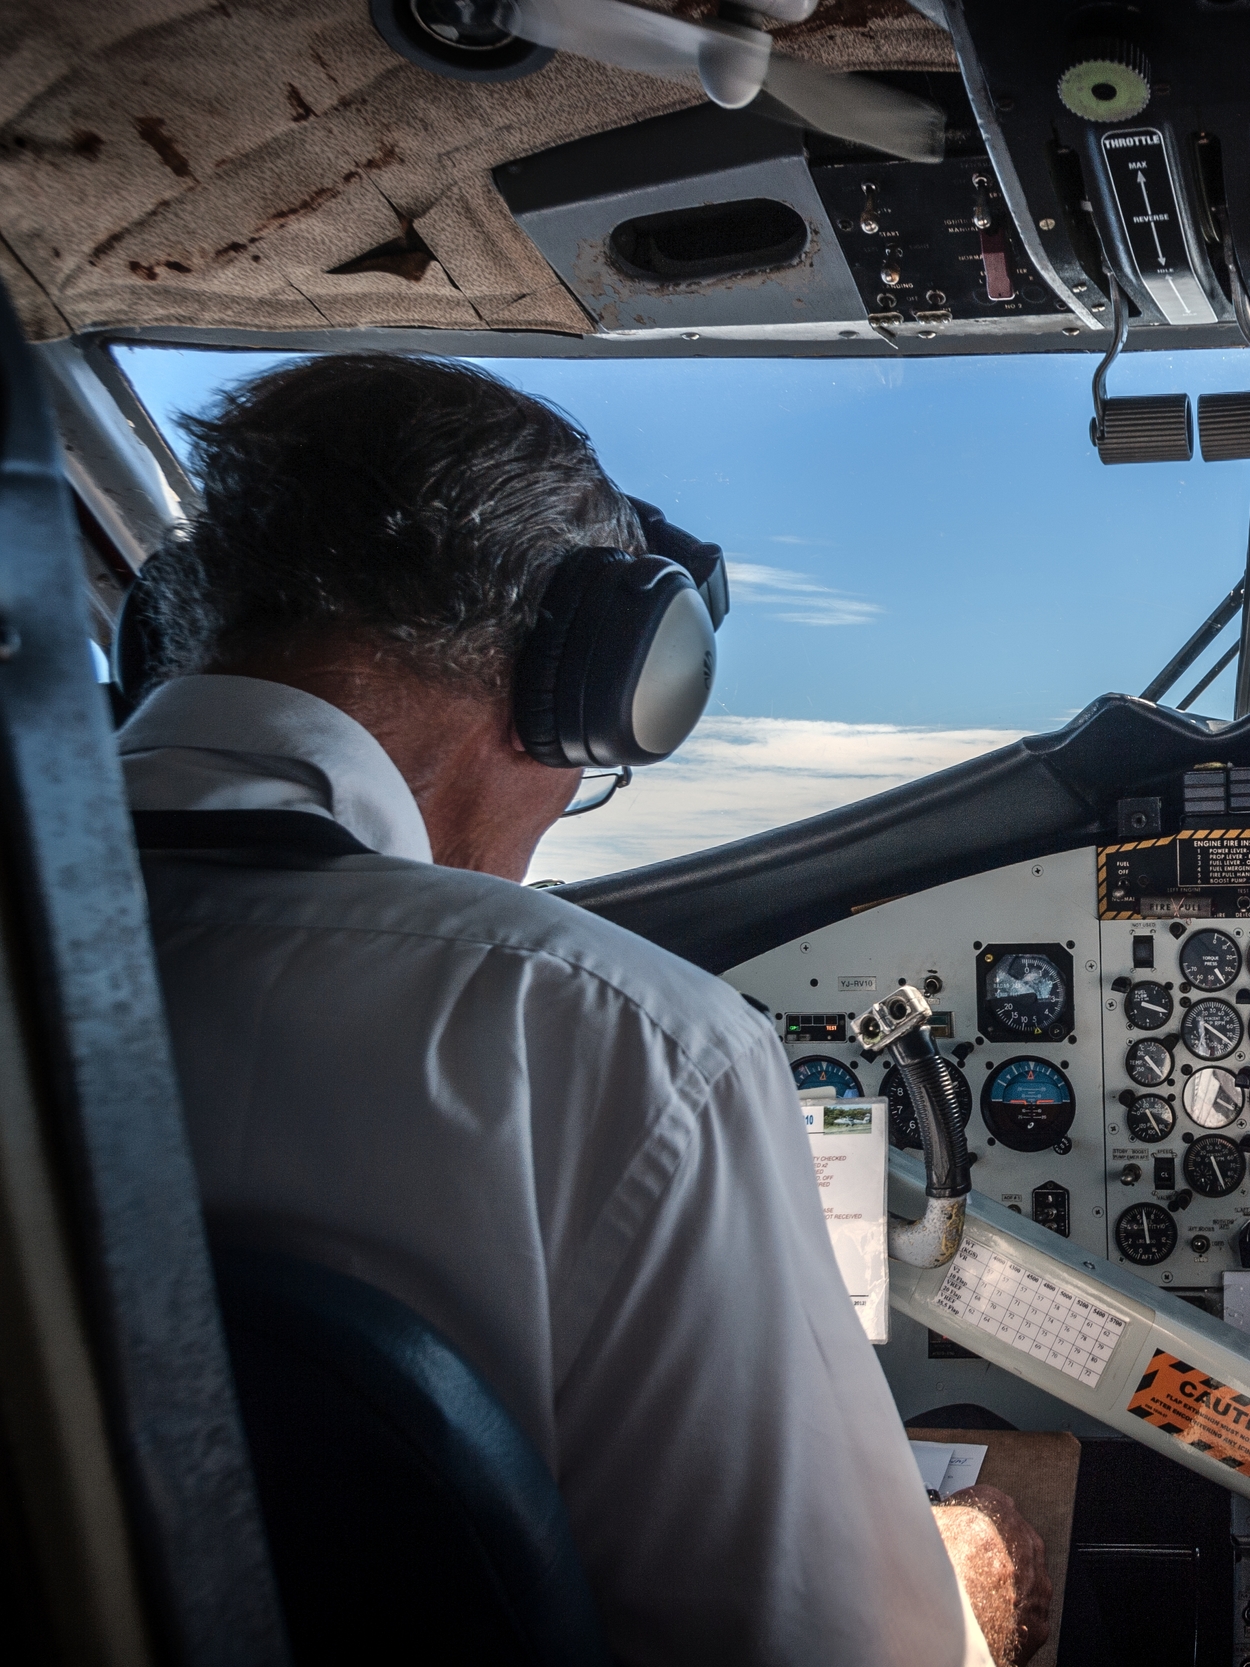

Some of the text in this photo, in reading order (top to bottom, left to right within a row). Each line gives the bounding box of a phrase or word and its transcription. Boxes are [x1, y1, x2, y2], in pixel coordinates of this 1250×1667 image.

[1104, 134, 1160, 150] THROTTLE
[1128, 161, 1148, 170] MAX
[1133, 213, 1169, 223] REVERSE
[1149, 902, 1201, 911] FIRE PULL
[840, 980, 873, 988] YJ-RV10
[897, 1087, 904, 1096] 8
[896, 1105, 903, 1114] 7
[909, 1120, 916, 1129] 6
[965, 1240, 975, 1249] WT
[959, 1253, 968, 1261] VR
[961, 1246, 979, 1260] (KGS)
[952, 1265, 961, 1273] V2
[947, 1279, 962, 1291] VREF
[1008, 1264, 1123, 1327] 4300 4500 4800 5000 5200 5400 5700
[1166, 1394, 1182, 1406] FLAP
[1220, 1422, 1239, 1435] MUST
[1150, 1396, 1172, 1411] AFTER
[1222, 1437, 1236, 1448] ANY
